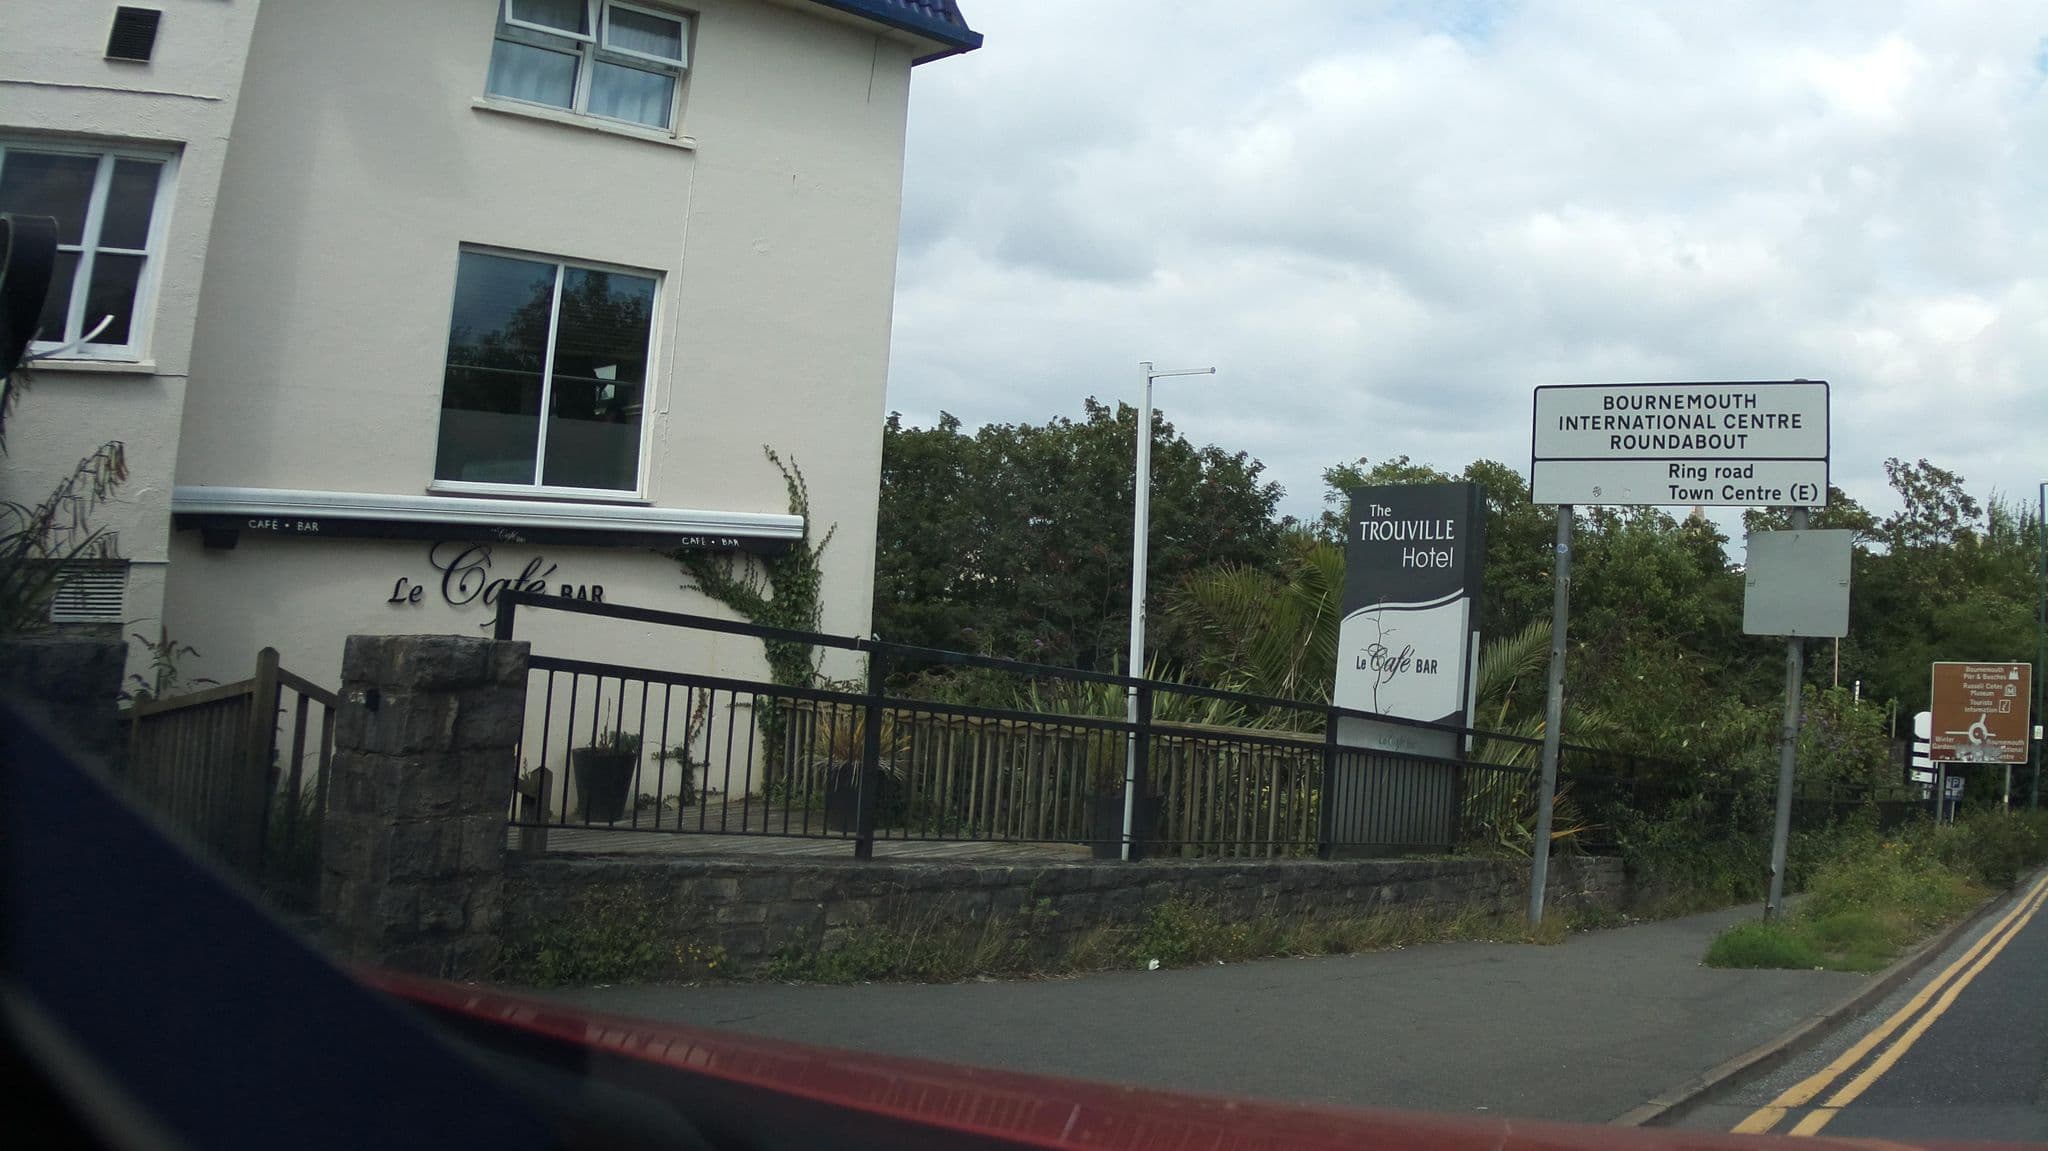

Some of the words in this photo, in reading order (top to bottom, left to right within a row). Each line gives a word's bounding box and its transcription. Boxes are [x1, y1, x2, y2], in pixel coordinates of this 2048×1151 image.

[1603, 393, 1757, 411] BOURNEMOUTH
[1558, 414, 1716, 431] INTERNATIONAL
[1723, 413, 1803, 430] CENTRE
[1609, 433, 1749, 450] ROUNDABOUT
[1668, 463, 1708, 482] Ring
[1714, 463, 1754, 479] road
[1668, 485, 1714, 500] Town
[1721, 485, 1782, 501] Centre
[1789, 484, 1819, 502] (E)
[1369, 504, 1392, 517] The
[297, 521, 319, 531] BAR
[1359, 519, 1455, 541] TROUVILLE
[1402, 547, 1454, 568] Hotel
[388, 577, 424, 603] Le
[561, 583, 604, 603] BAR
[1356, 655, 1366, 670] Le
[1416, 658, 1438, 674] BAR
